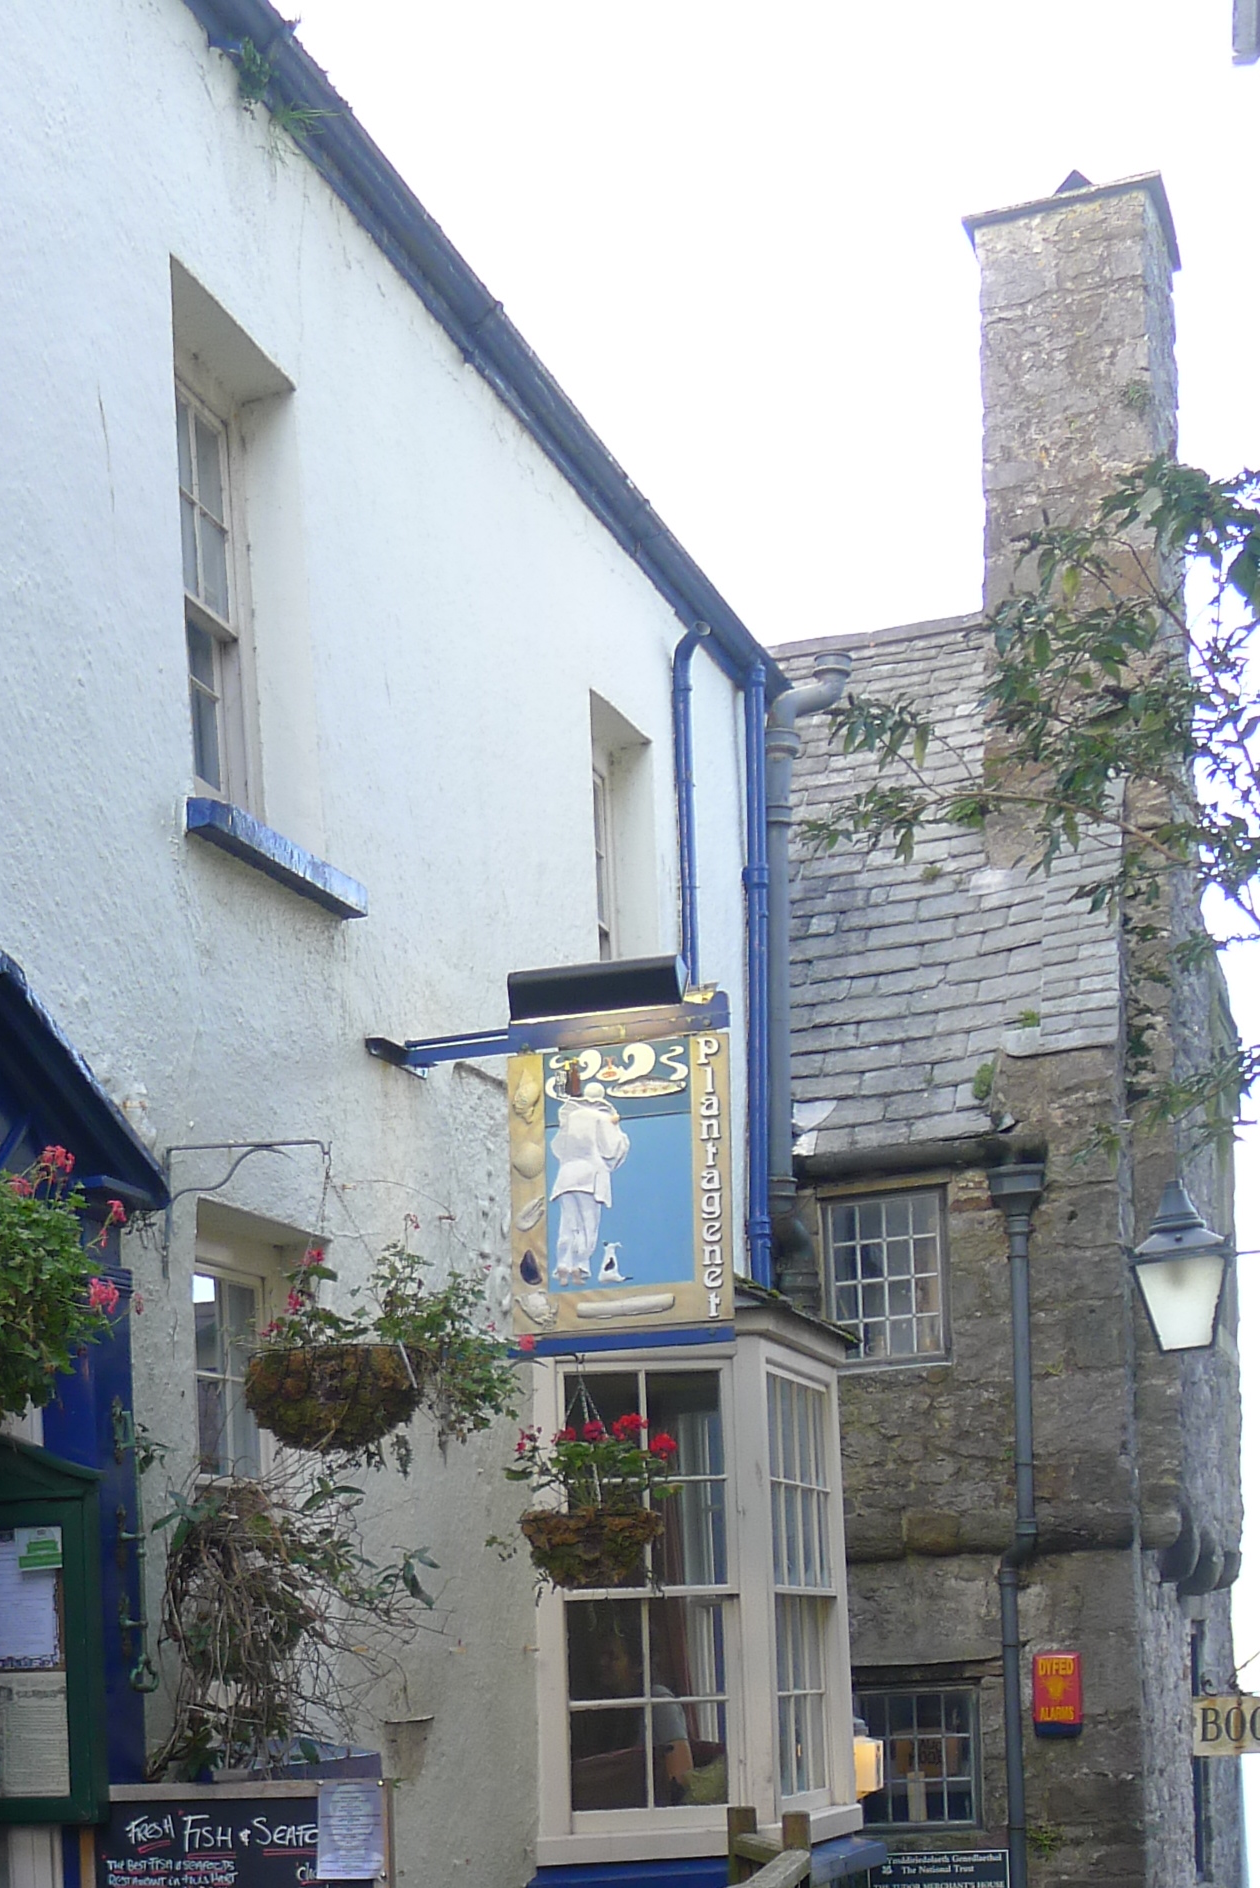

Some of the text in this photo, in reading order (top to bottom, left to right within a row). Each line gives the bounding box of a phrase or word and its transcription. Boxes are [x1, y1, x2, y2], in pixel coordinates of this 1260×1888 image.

[696, 1037, 724, 1318] Plantagenet
[1038, 1658, 1074, 1676] DYFED
[1041, 1706, 1074, 1720] ALARMS
[182, 1814, 233, 1852] FISH
[902, 1865, 975, 1874] The National Trust
[977, 1881, 1005, 1888] HOUSE
